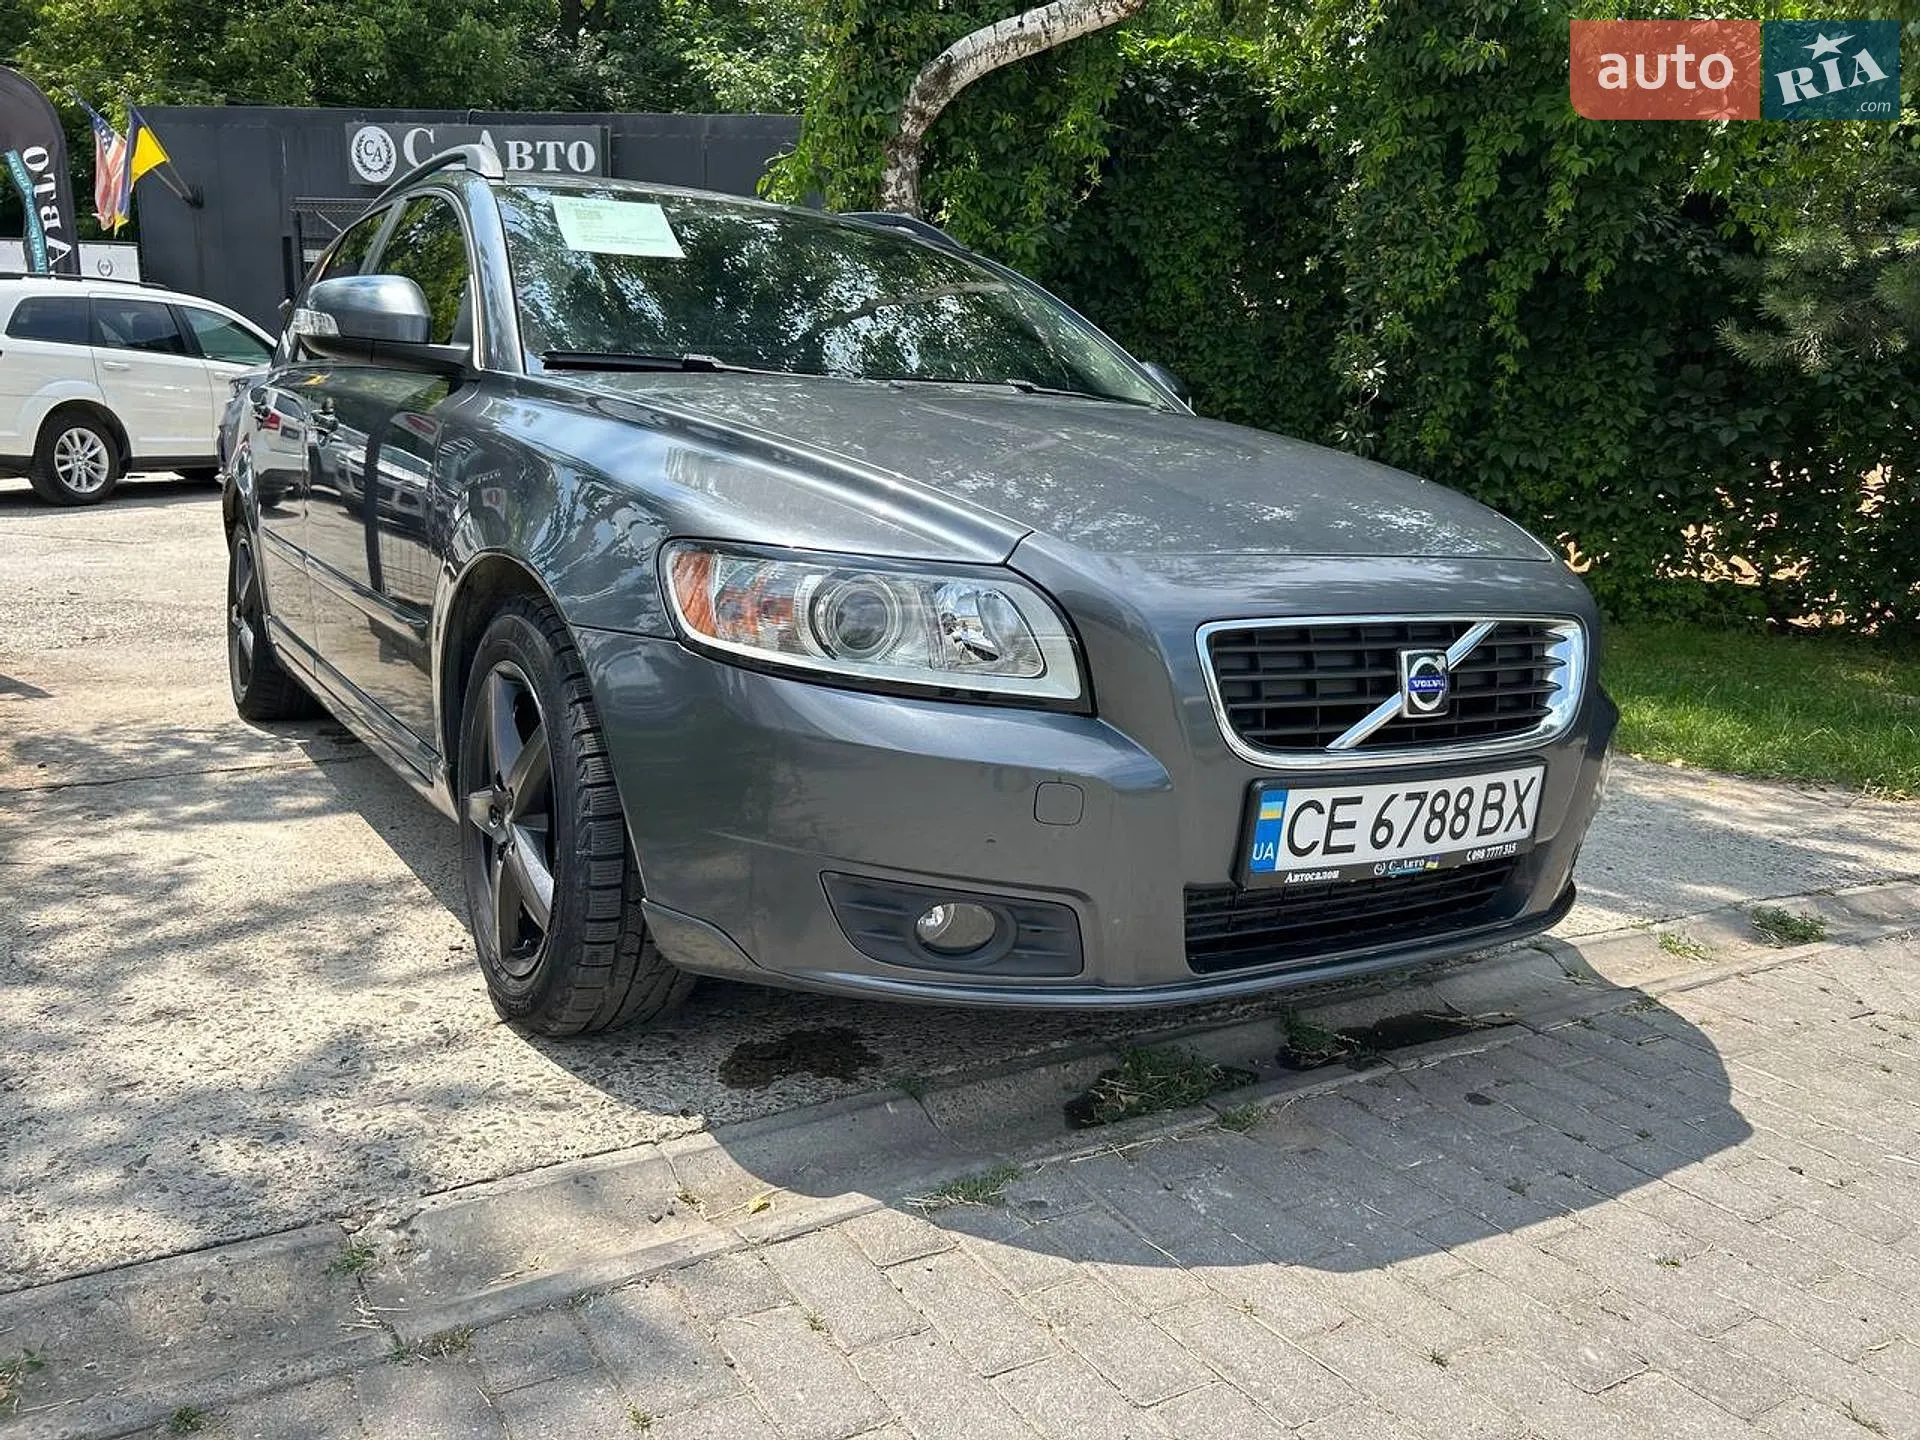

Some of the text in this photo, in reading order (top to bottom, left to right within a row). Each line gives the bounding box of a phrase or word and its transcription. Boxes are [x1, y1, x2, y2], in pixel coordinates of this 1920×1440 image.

[1411, 679, 1445, 688] VOLVO
[1286, 776, 1536, 858] CE 6788 BX
[1252, 841, 1275, 861] UA
[1284, 869, 1340, 884] Автосалон
